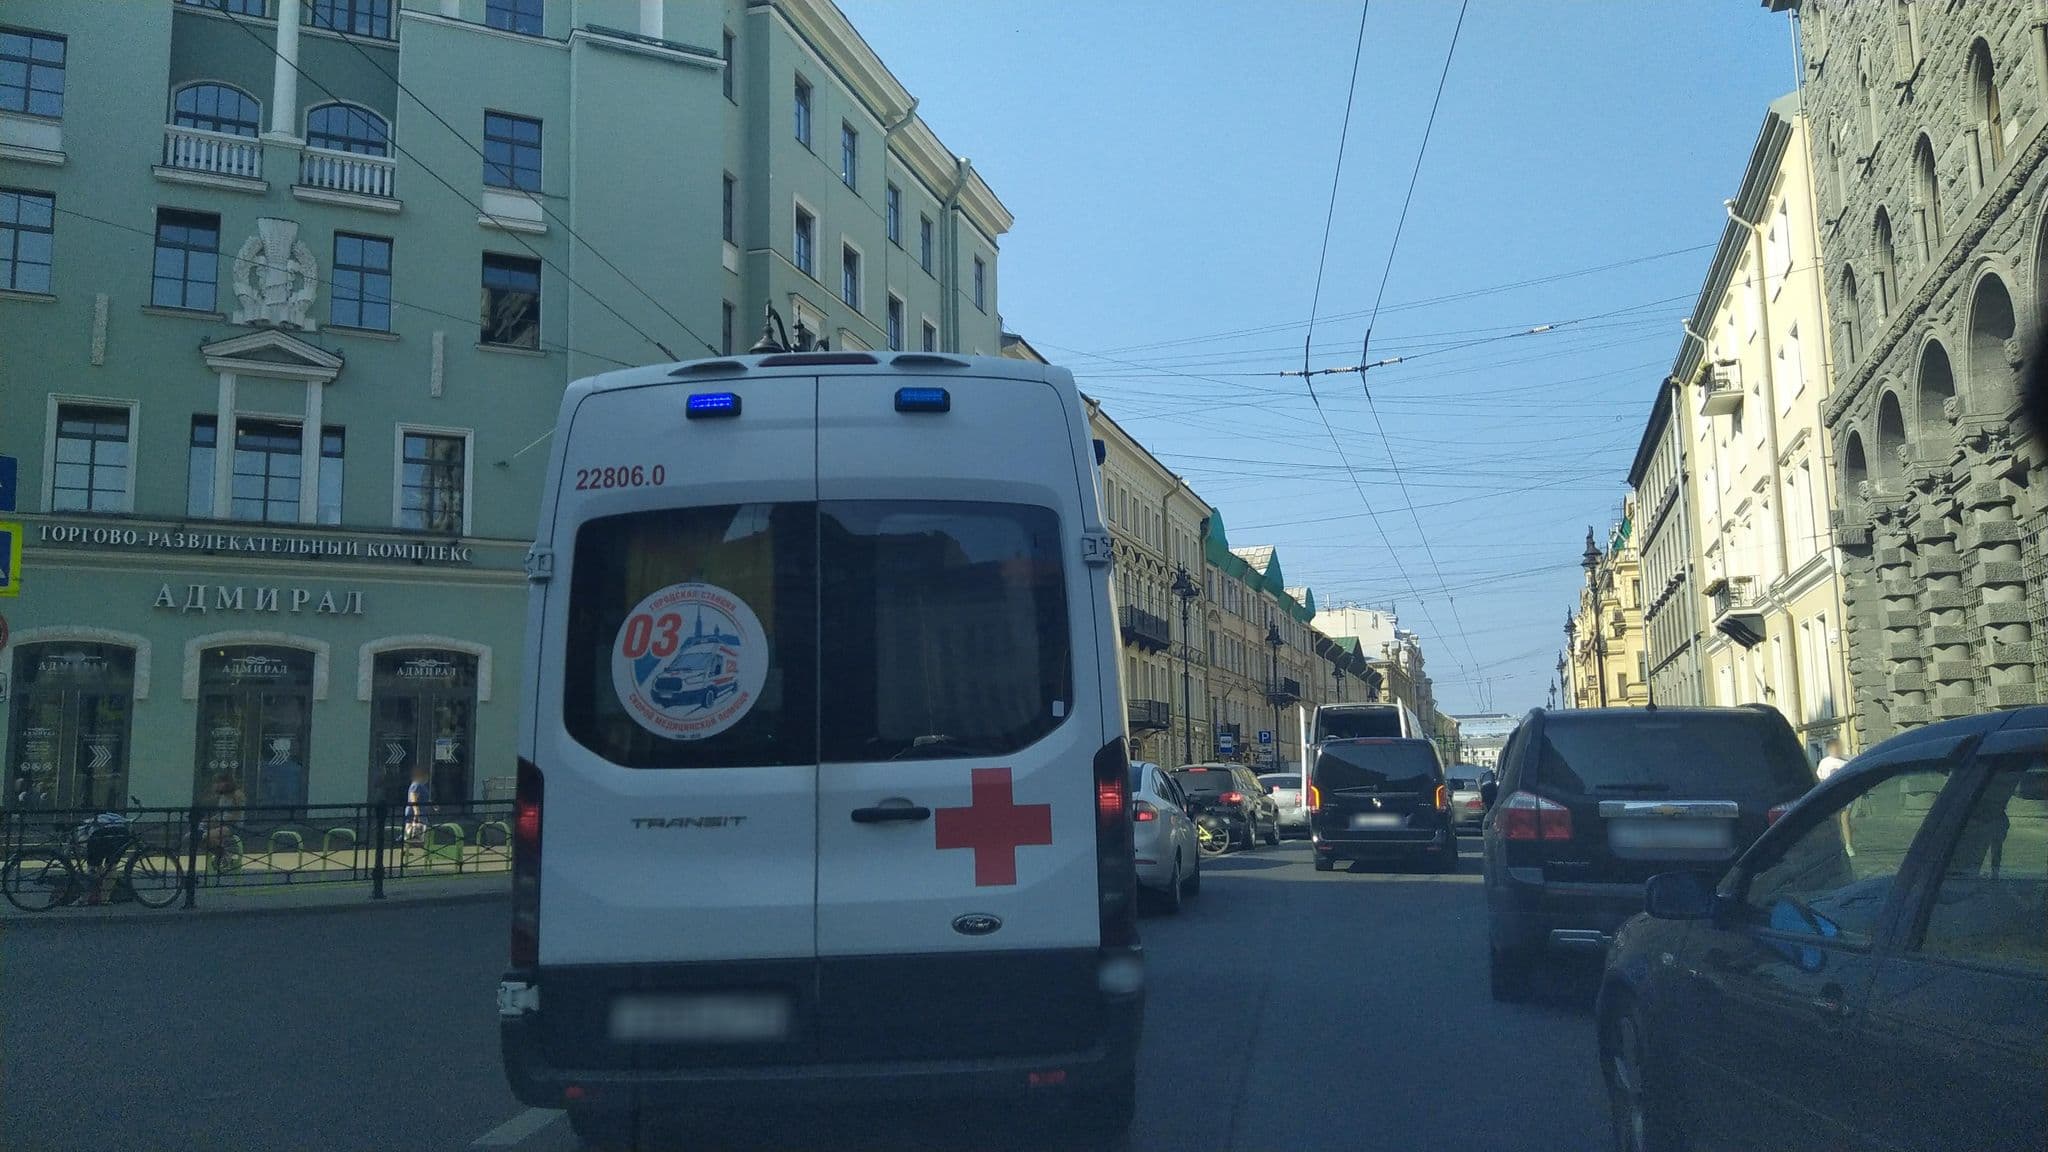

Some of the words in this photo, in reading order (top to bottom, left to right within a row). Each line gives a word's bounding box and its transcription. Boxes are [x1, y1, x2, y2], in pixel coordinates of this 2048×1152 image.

[575, 464, 665, 490] 22806.0
[38, 525, 358, 556] ТОРГОВО-РАЗВЛЕКАТЕЛЬНЫЙ
[367, 542, 473, 561] КОМПЛЕКС
[152, 583, 364, 614] АДМИРАЛ
[622, 612, 682, 659] 03
[222, 665, 288, 675] АДМИРАЛ
[396, 667, 456, 676] АДМИРАЛ
[1261, 732, 1270, 742] P
[631, 816, 748, 829] TRANSIT
